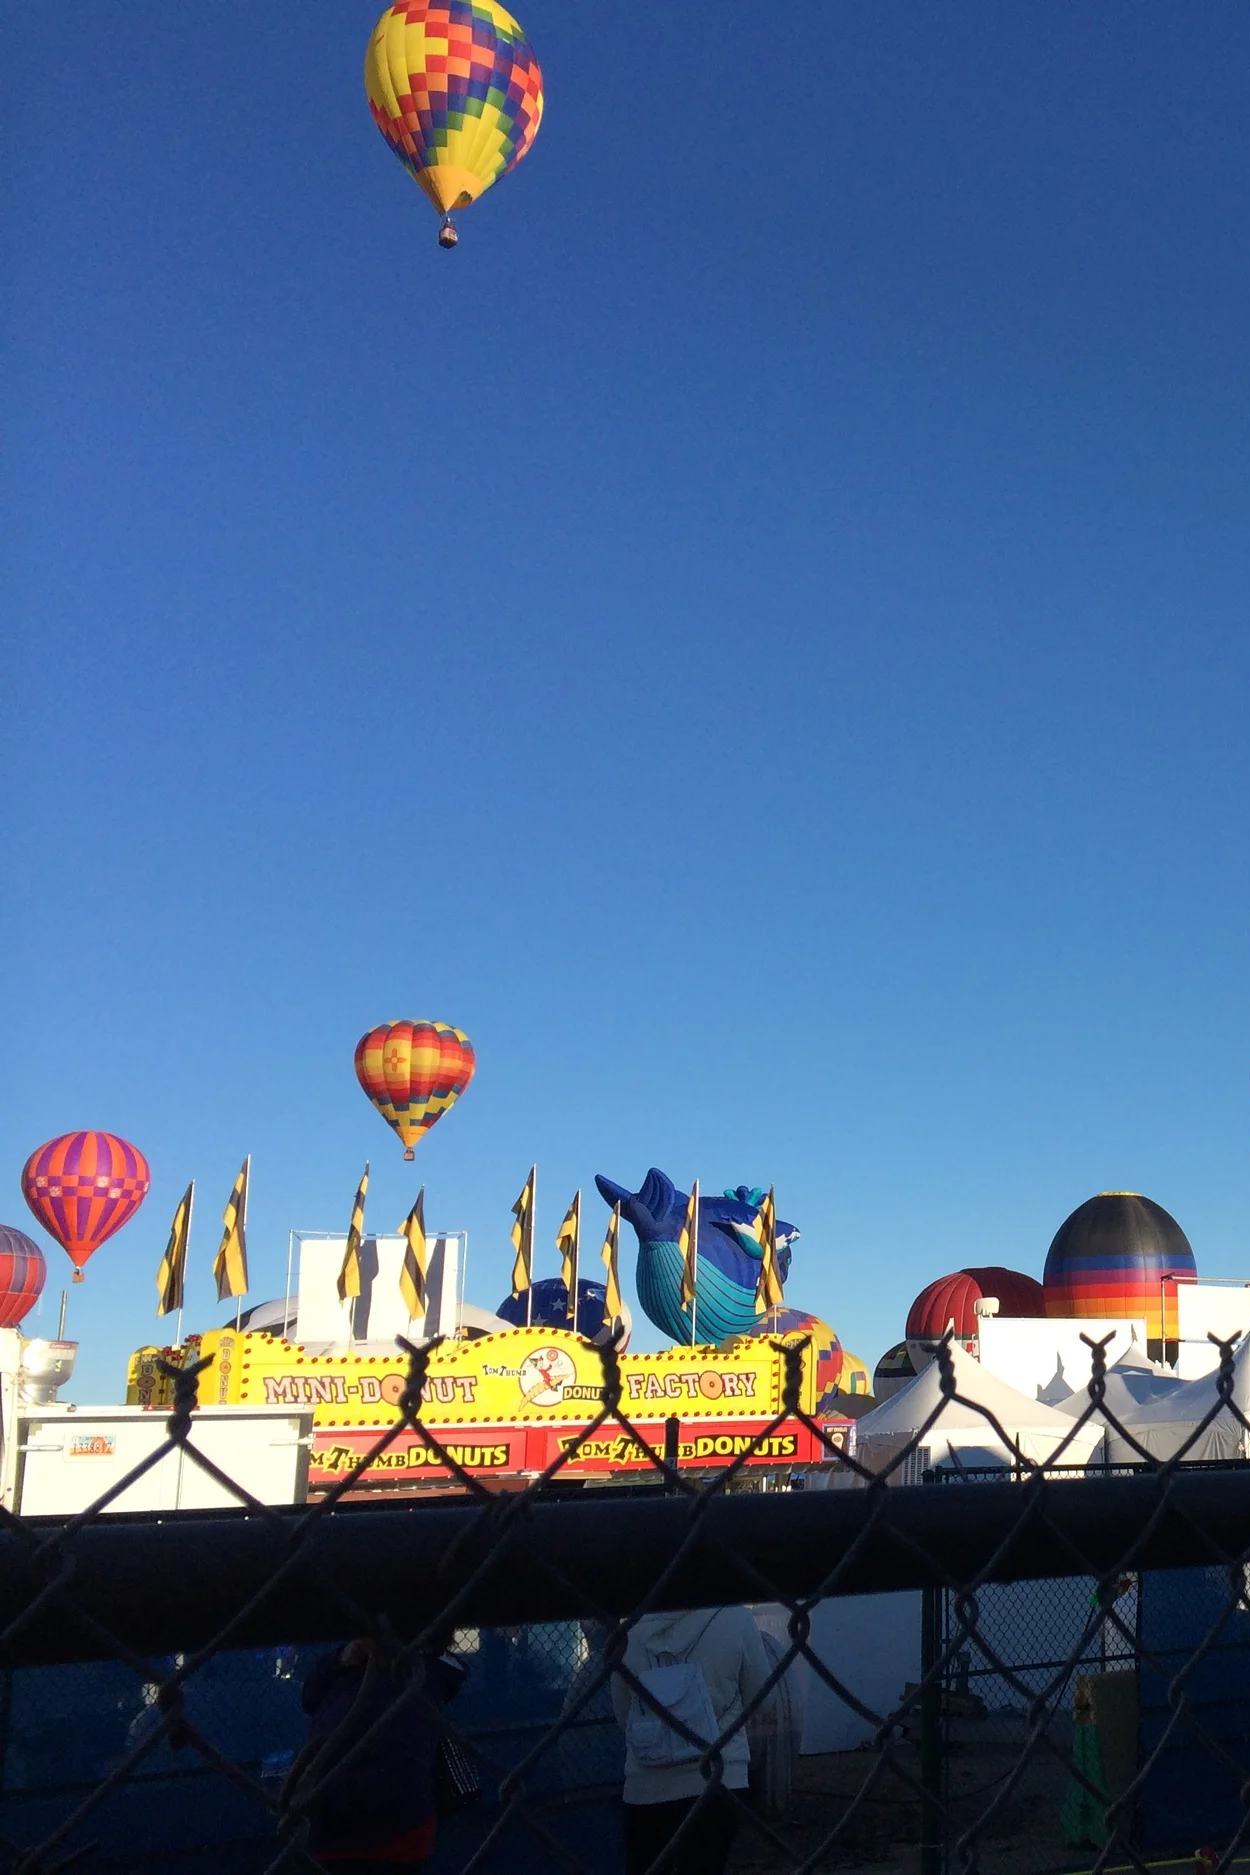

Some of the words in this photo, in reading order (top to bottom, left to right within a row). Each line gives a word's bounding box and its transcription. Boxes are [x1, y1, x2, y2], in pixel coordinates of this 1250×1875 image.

[627, 1370, 757, 1400] FACTORY
[409, 1445, 507, 1467] DONUTS
[696, 1436, 795, 1457] DONUTS
